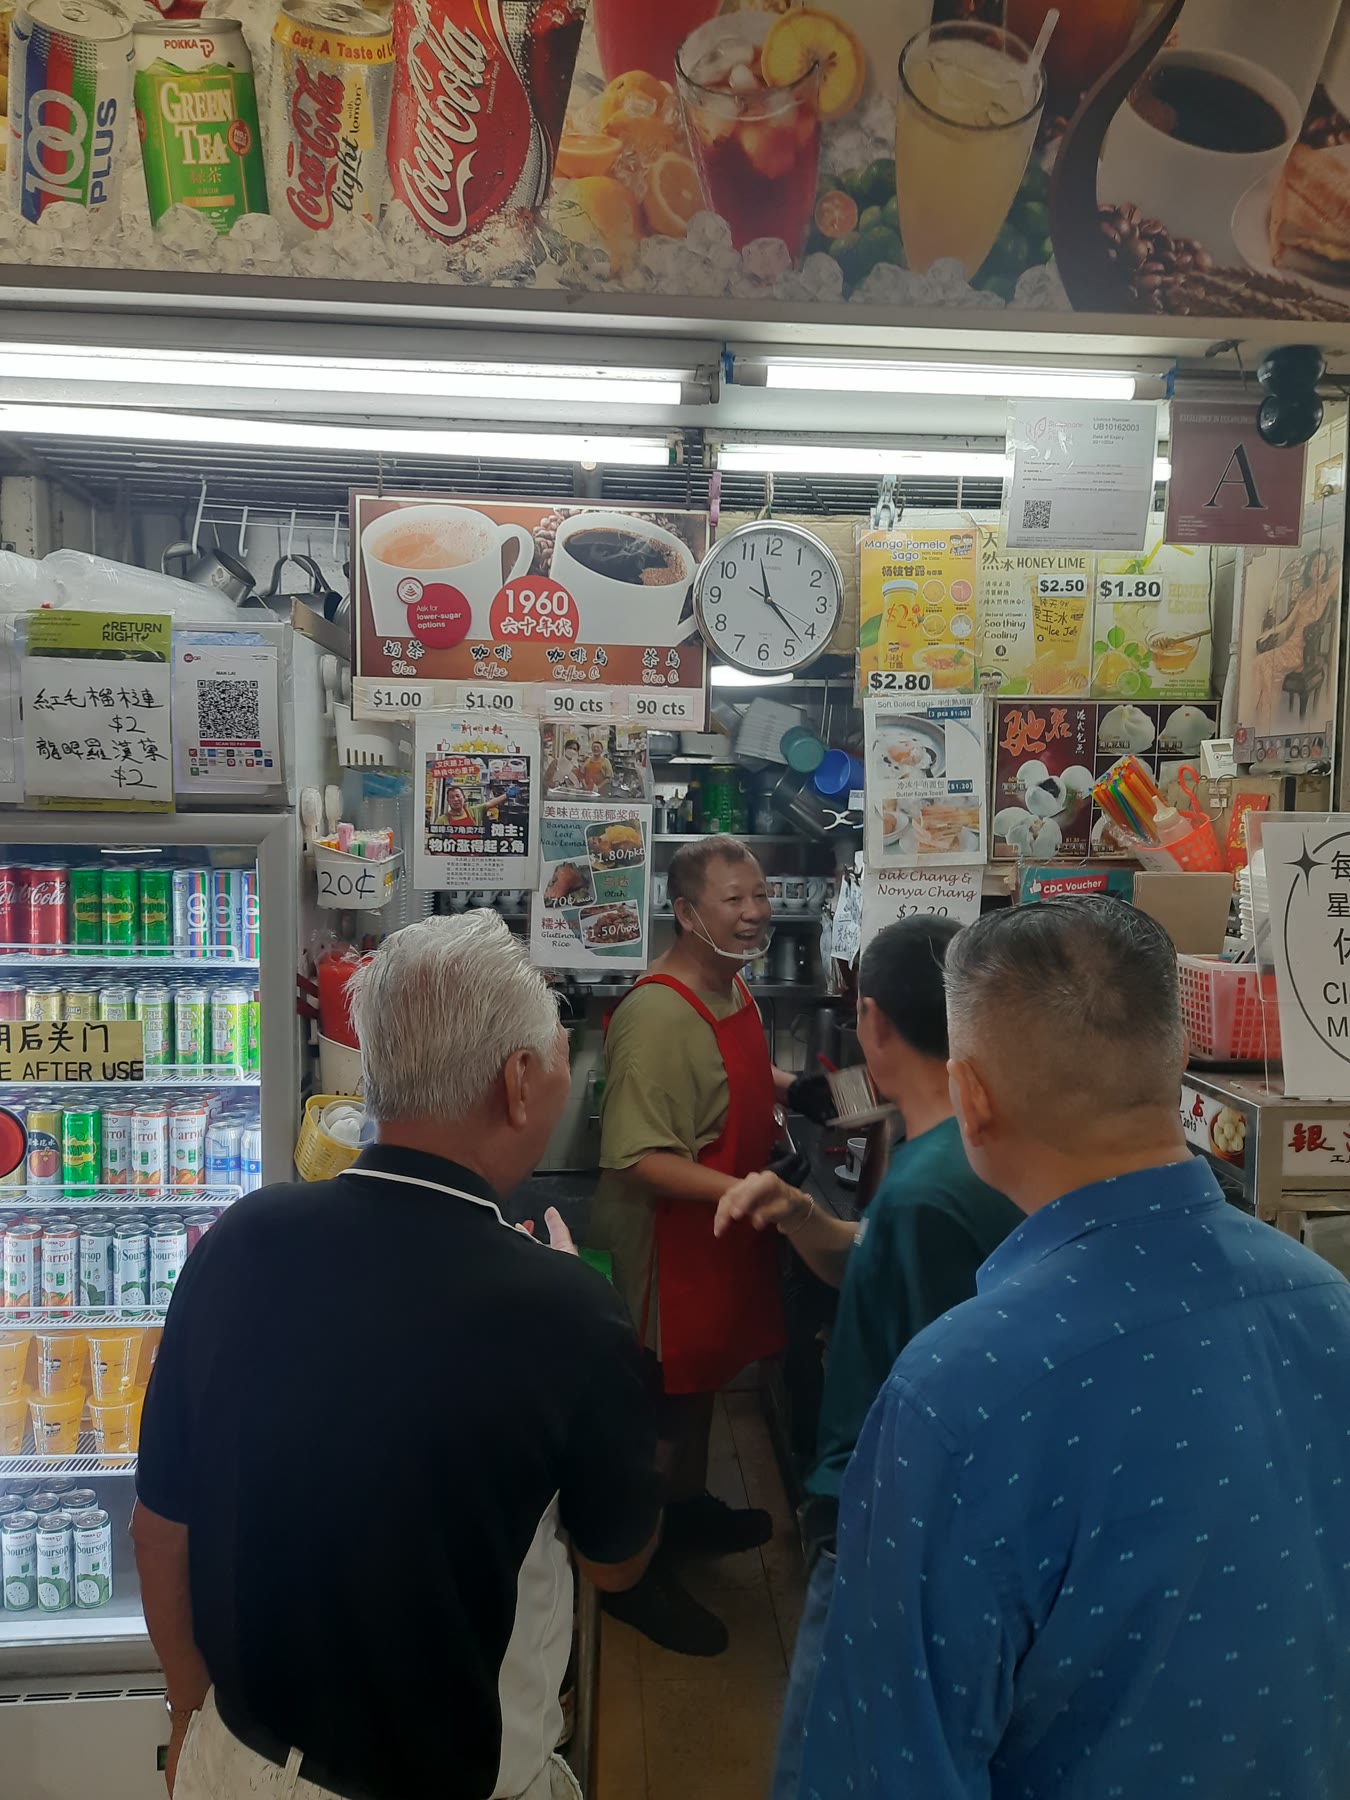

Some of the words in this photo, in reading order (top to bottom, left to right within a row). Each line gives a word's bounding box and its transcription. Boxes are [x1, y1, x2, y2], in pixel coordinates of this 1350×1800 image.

[163, 39, 199, 50] POKKA
[292, 31, 314, 50] Get
[319, 40, 330, 55] A
[337, 42, 373, 60] Taste
[161, 82, 235, 125] GREEN
[399, 16, 487, 237] Coca-Cola
[26, 89, 88, 200] 100
[90, 98, 117, 205] PLUS
[174, 124, 230, 165] TEA
[286, 60, 345, 231] Coca-Cola
[331, 135, 364, 213] light
[1093, 423, 1140, 432] UB10162003
[1202, 442, 1268, 510] A
[742, 542, 756, 561] 11
[766, 537, 784, 557] 12
[864, 540, 904, 551] Mango
[906, 540, 946, 550] Pomelo
[797, 548, 802, 566] 1
[892, 551, 919, 562] Sago
[1017, 557, 1056, 569] HONEY
[1058, 557, 1086, 569] LIME
[720, 561, 737, 579] 10
[809, 569, 823, 588] 2
[709, 586, 722, 604] 9
[1040, 579, 1084, 593] $2.50
[1100, 579, 1161, 598] $1.80
[505, 589, 569, 616] 1960
[815, 596, 827, 615] 3
[416, 612, 462, 621] lower-sugar
[417, 621, 446, 629] options
[715, 614, 727, 632] 8
[985, 619, 1026, 631] Soothing
[102, 631, 141, 642] RIGHT
[111, 622, 162, 633] RETURN
[500, 618, 574, 639] 六十年代
[804, 623, 816, 640] 4
[984, 630, 1018, 643] Cooling
[383, 640, 425, 660] 奶茶
[734, 634, 746, 652] 7
[757, 643, 770, 661] 6
[783, 639, 796, 657] 5
[471, 644, 512, 661] 咖啡
[391, 660, 417, 676] Tea
[473, 661, 509, 678] Coffee
[552, 664, 586, 681] Coffee
[641, 668, 666, 684] Tea
[870, 672, 931, 690] $2.80
[372, 688, 422, 709] $1.00
[466, 693, 513, 711] $1.00
[554, 696, 577, 713] 90
[580, 697, 604, 713] cts
[636, 699, 657, 716] 90
[662, 700, 686, 716] cts
[878, 701, 892, 709] Soft
[937, 710, 949, 718] pcs
[108, 714, 146, 733] $2
[110, 766, 158, 788] $2
[546, 822, 581, 830] Banana
[555, 831, 574, 839] Leaf
[560, 839, 587, 848] Lemak
[321, 869, 377, 901] 20¢
[878, 869, 907, 881] Bak
[910, 871, 959, 886] Chang
[961, 872, 973, 884] &
[31, 882, 66, 905] Cola
[604, 890, 627, 898] Otah
[877, 884, 926, 899] Nonya
[928, 886, 977, 902] Chang
[1043, 884, 1063, 894] CDC
[1065, 880, 1102, 891] Voucher
[896, 904, 948, 920] $220
[552, 940, 571, 948] Rice
[1323, 982, 1350, 1005] Cl
[22, 1061, 93, 1081] AFTER
[102, 1060, 144, 1081] USE
[171, 1126, 204, 1141] Carrot
[1288, 1122, 1350, 1152] 银
[1330, 1154, 1350, 1164] 工
[77, 1540, 108, 1556] Soursop
